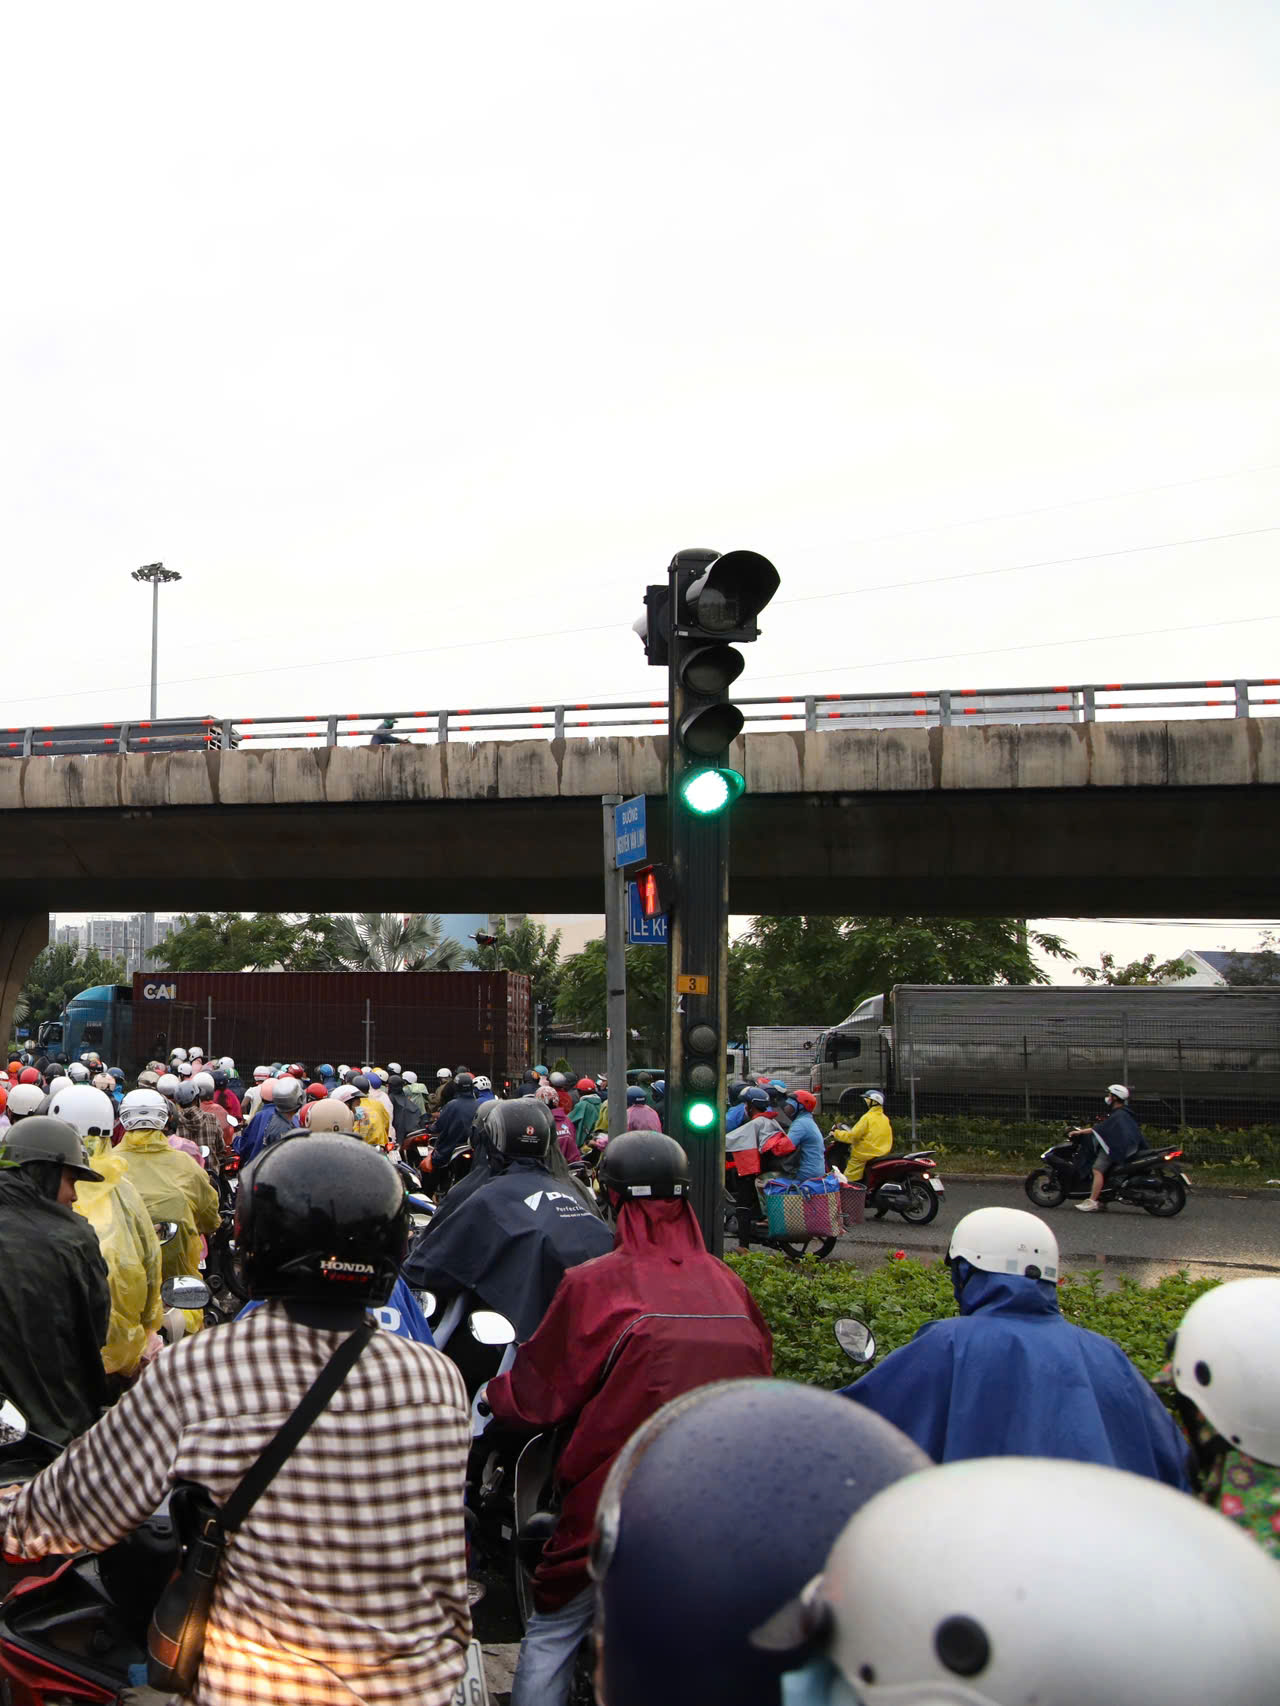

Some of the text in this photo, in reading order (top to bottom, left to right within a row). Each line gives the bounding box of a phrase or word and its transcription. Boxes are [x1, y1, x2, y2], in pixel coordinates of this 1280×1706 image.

[688, 977, 697, 991] 3
[143, 983, 176, 1000] CAI
[320, 1260, 375, 1274] HONDA
